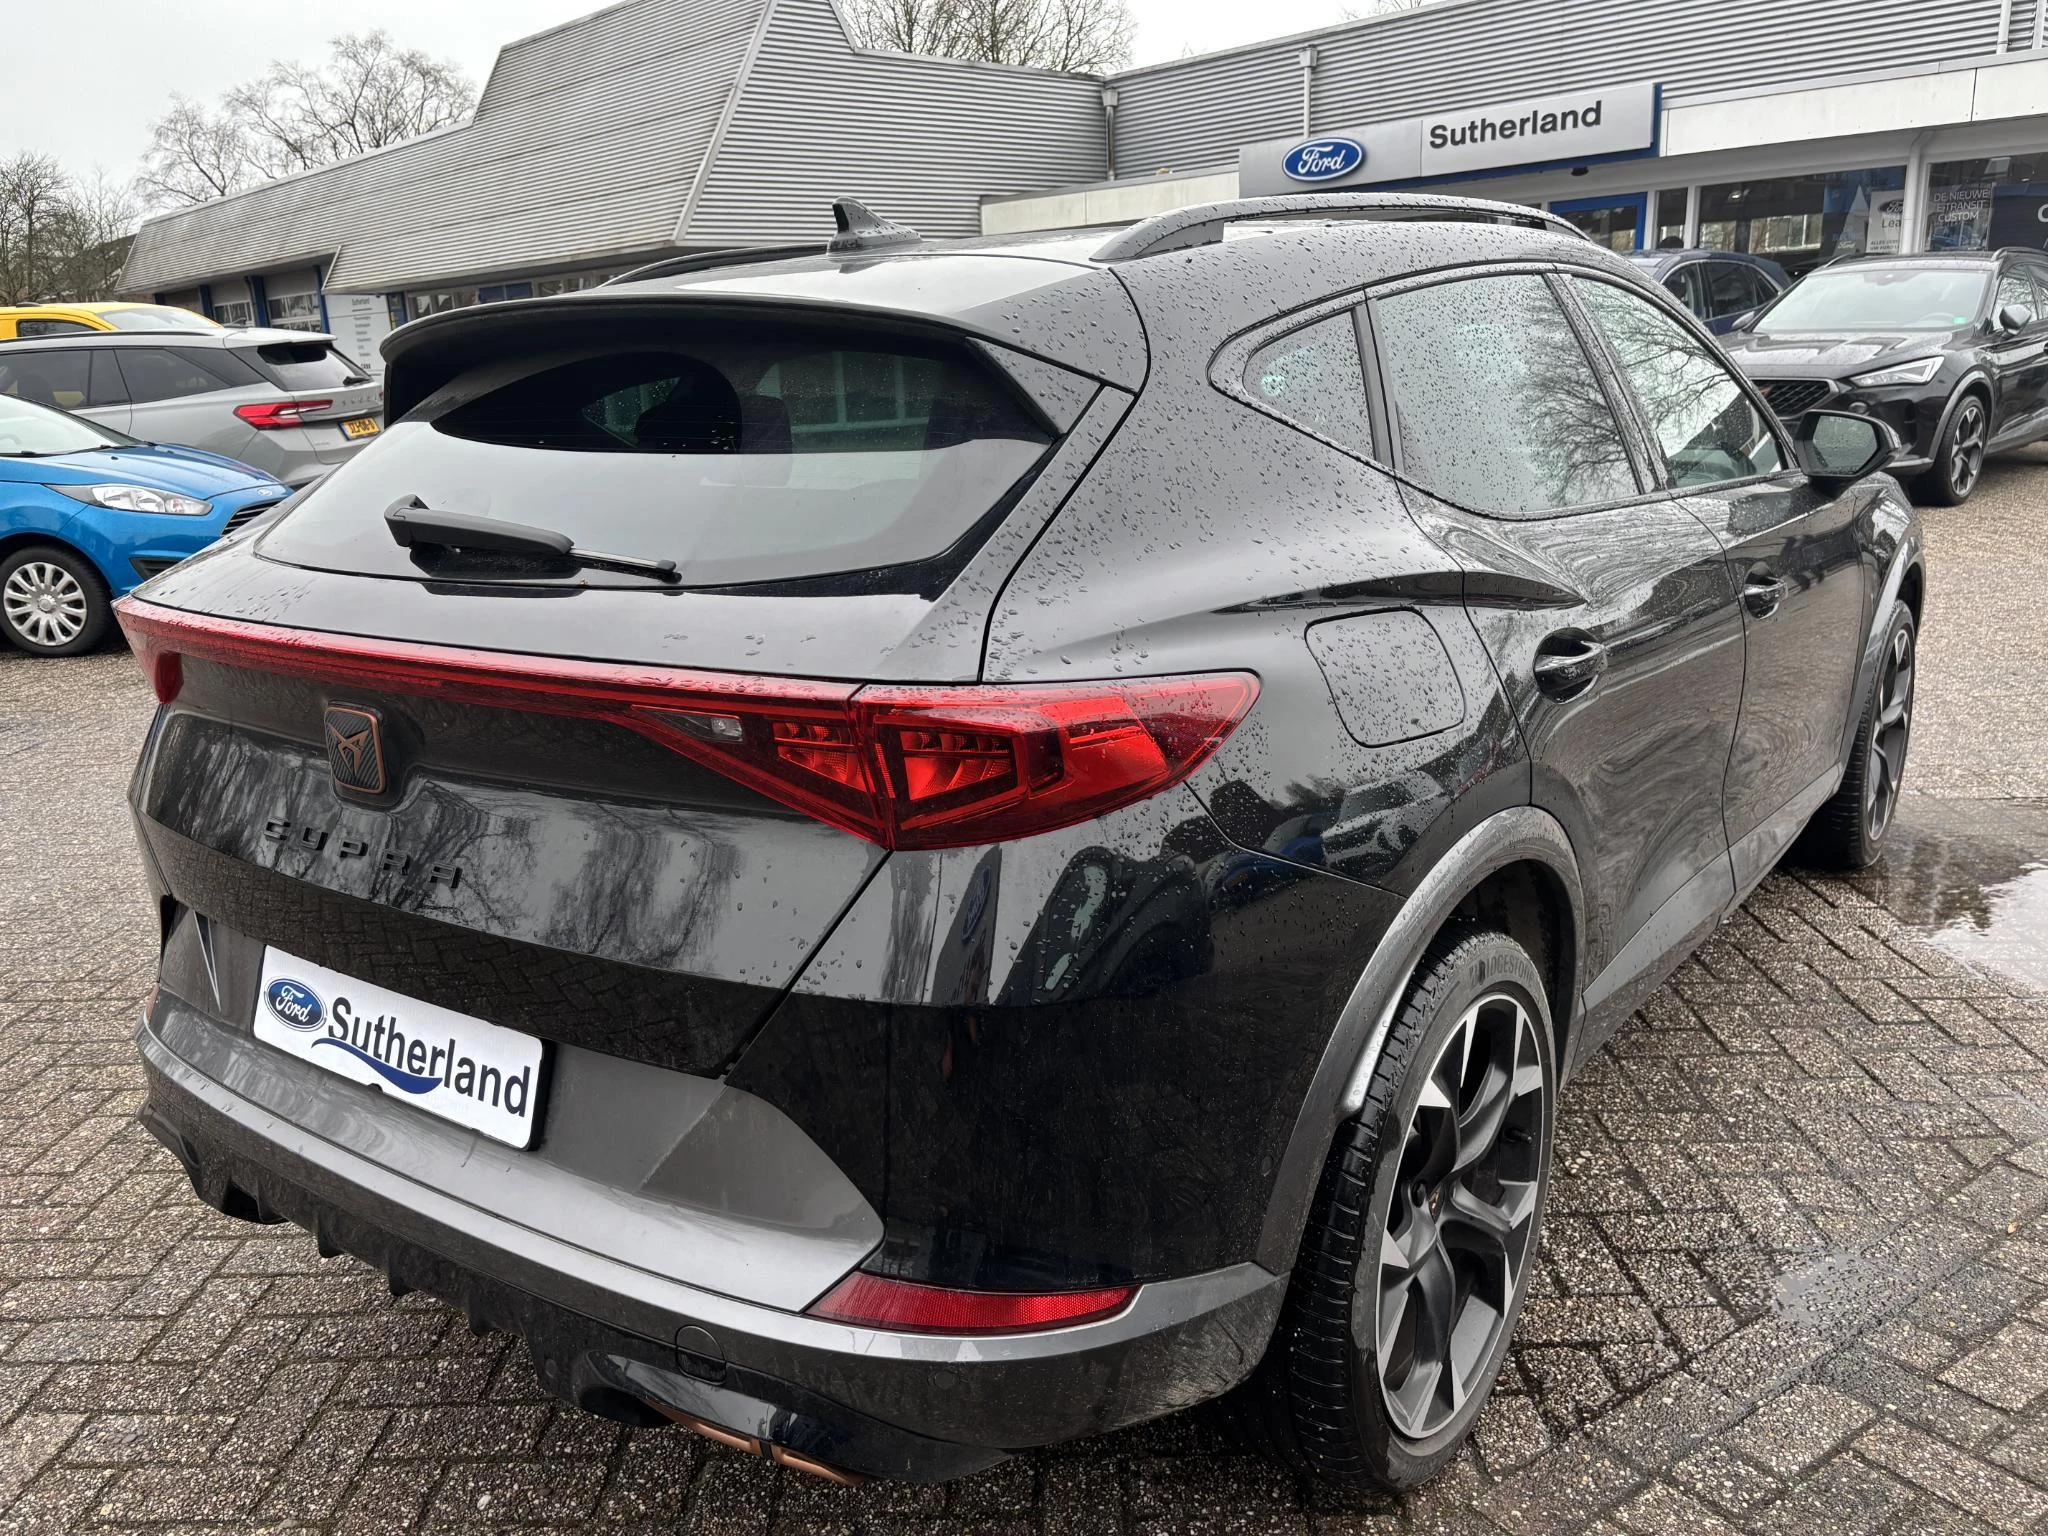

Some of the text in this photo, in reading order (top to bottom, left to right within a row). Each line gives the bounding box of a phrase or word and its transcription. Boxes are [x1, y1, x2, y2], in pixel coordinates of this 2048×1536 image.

[1298, 100, 1603, 177] Ford Sutherland
[1934, 193, 1946, 202] DE
[1938, 211, 1979, 223] CUSTOM
[264, 817, 463, 889] CUPRA
[276, 984, 531, 1118] Ford Sutherland
